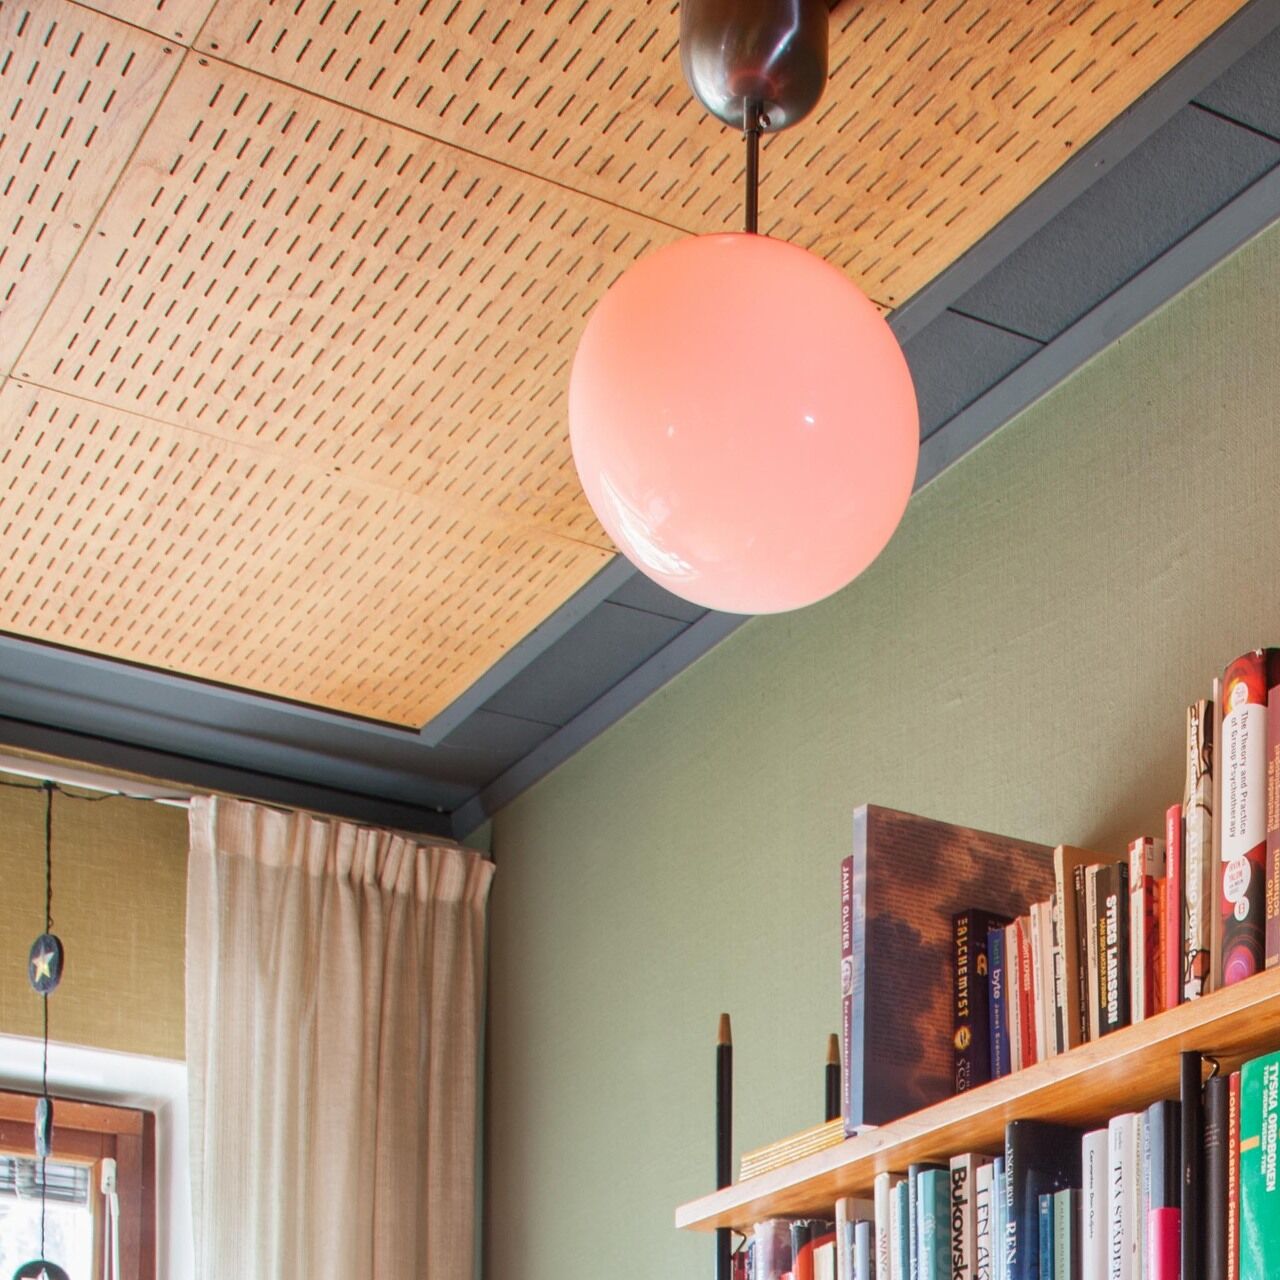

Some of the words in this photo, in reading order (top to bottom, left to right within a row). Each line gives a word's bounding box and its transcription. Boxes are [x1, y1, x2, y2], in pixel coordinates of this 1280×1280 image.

[1230, 717, 1238, 730] of
[1240, 711, 1249, 730] The
[1228, 731, 1238, 763] Group
[1239, 733, 1249, 773] Theory
[1228, 764, 1238, 838] Psychotherapy
[1240, 775, 1249, 791] and
[1239, 792, 1249, 835] Practice
[842, 866, 850, 902] JAMIE
[1266, 879, 1274, 920] rocko
[1273, 848, 1280, 917] schamoni
[842, 906, 850, 951] OLIVER
[1105, 894, 1117, 946] STIEG
[957, 927, 969, 1018] ALCHEMYST
[991, 968, 1002, 999] byte
[1106, 948, 1119, 1024] LARSSON
[1266, 1062, 1279, 1111] TYSKA
[1228, 1091, 1236, 1137] JONAS
[1228, 1140, 1236, 1197] GARDELL
[1265, 1113, 1279, 1192] ORDBOKEN
[1111, 1160, 1123, 1201] TVÅ
[1005, 1221, 1017, 1265] REN
[1111, 1204, 1123, 1280] STÄDER
